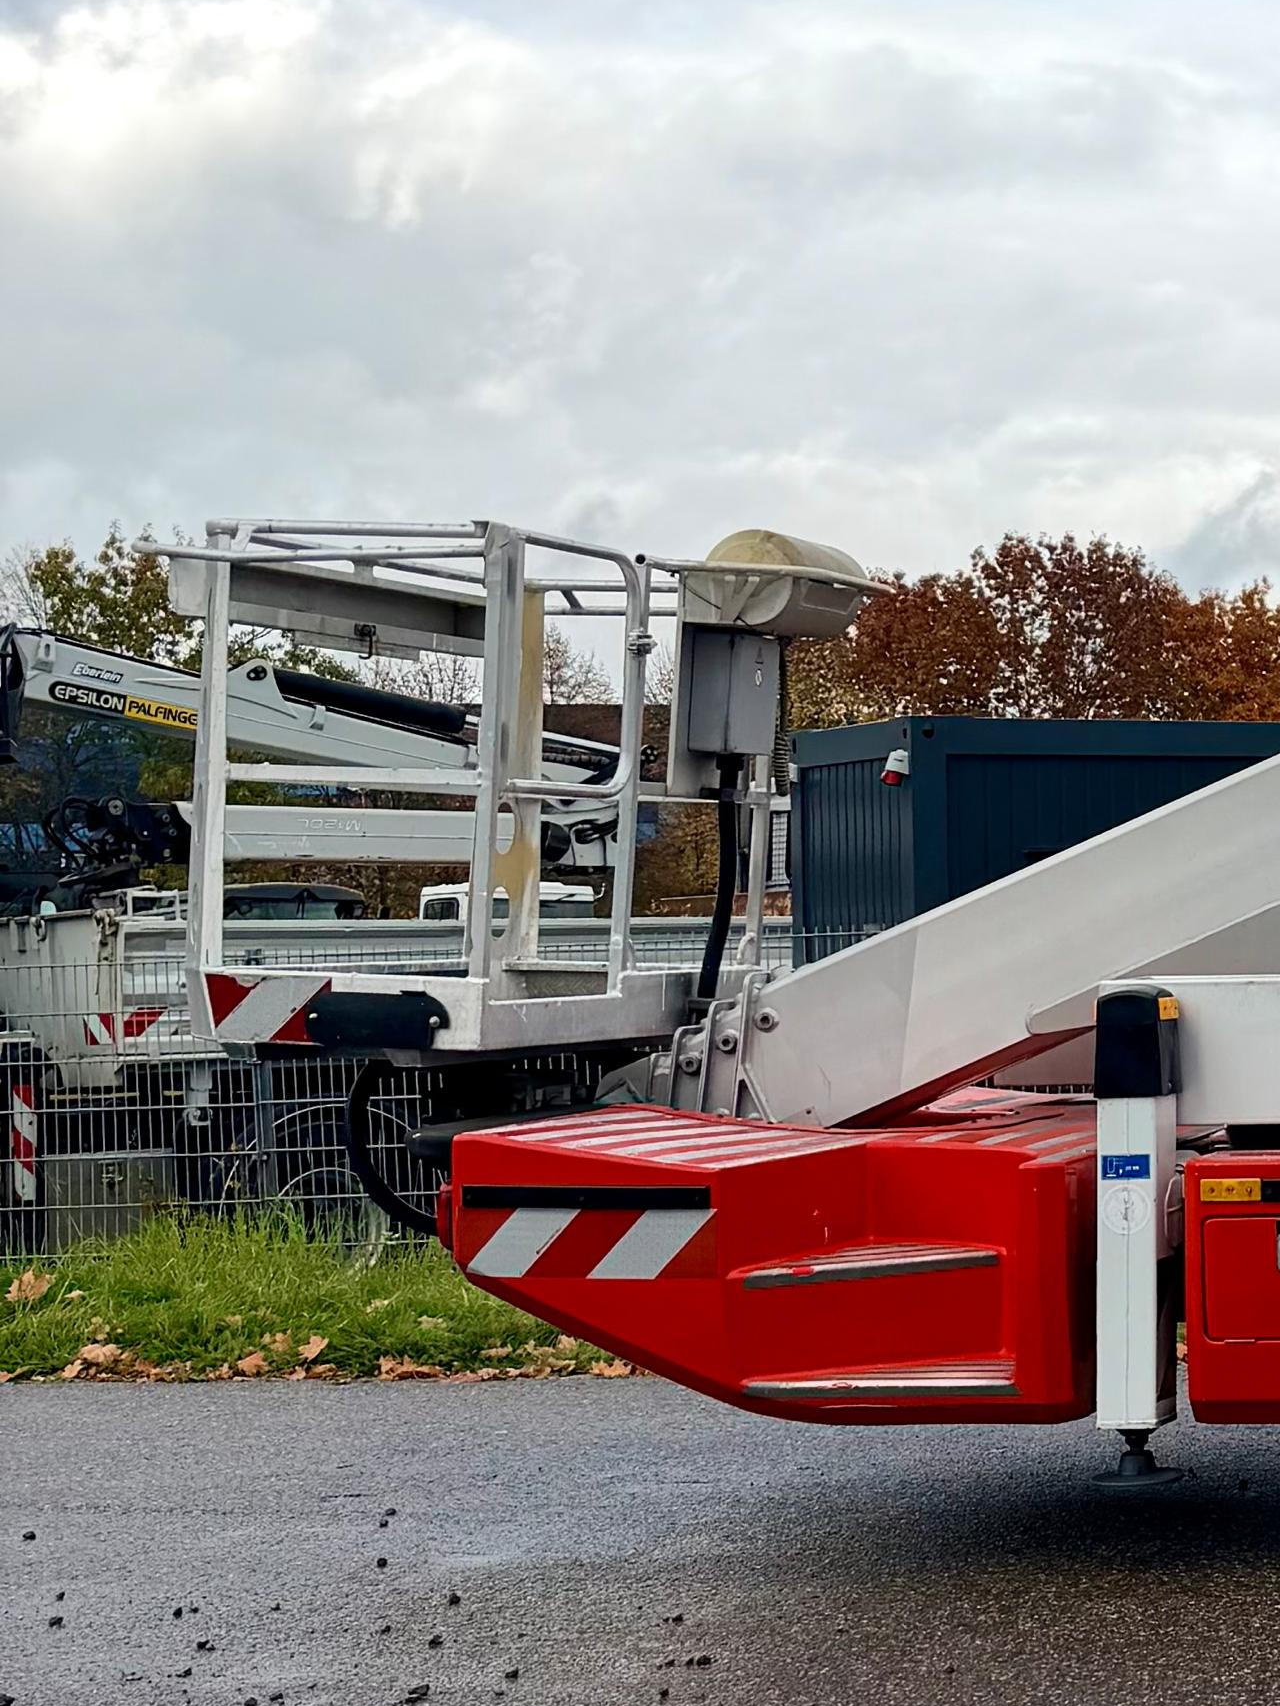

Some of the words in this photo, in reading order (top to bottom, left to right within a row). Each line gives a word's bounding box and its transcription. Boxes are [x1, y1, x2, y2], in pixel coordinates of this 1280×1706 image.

[72, 663, 122, 683] Eberlein
[54, 685, 125, 712] EPSILON
[127, 700, 198, 726] PALFINGE
